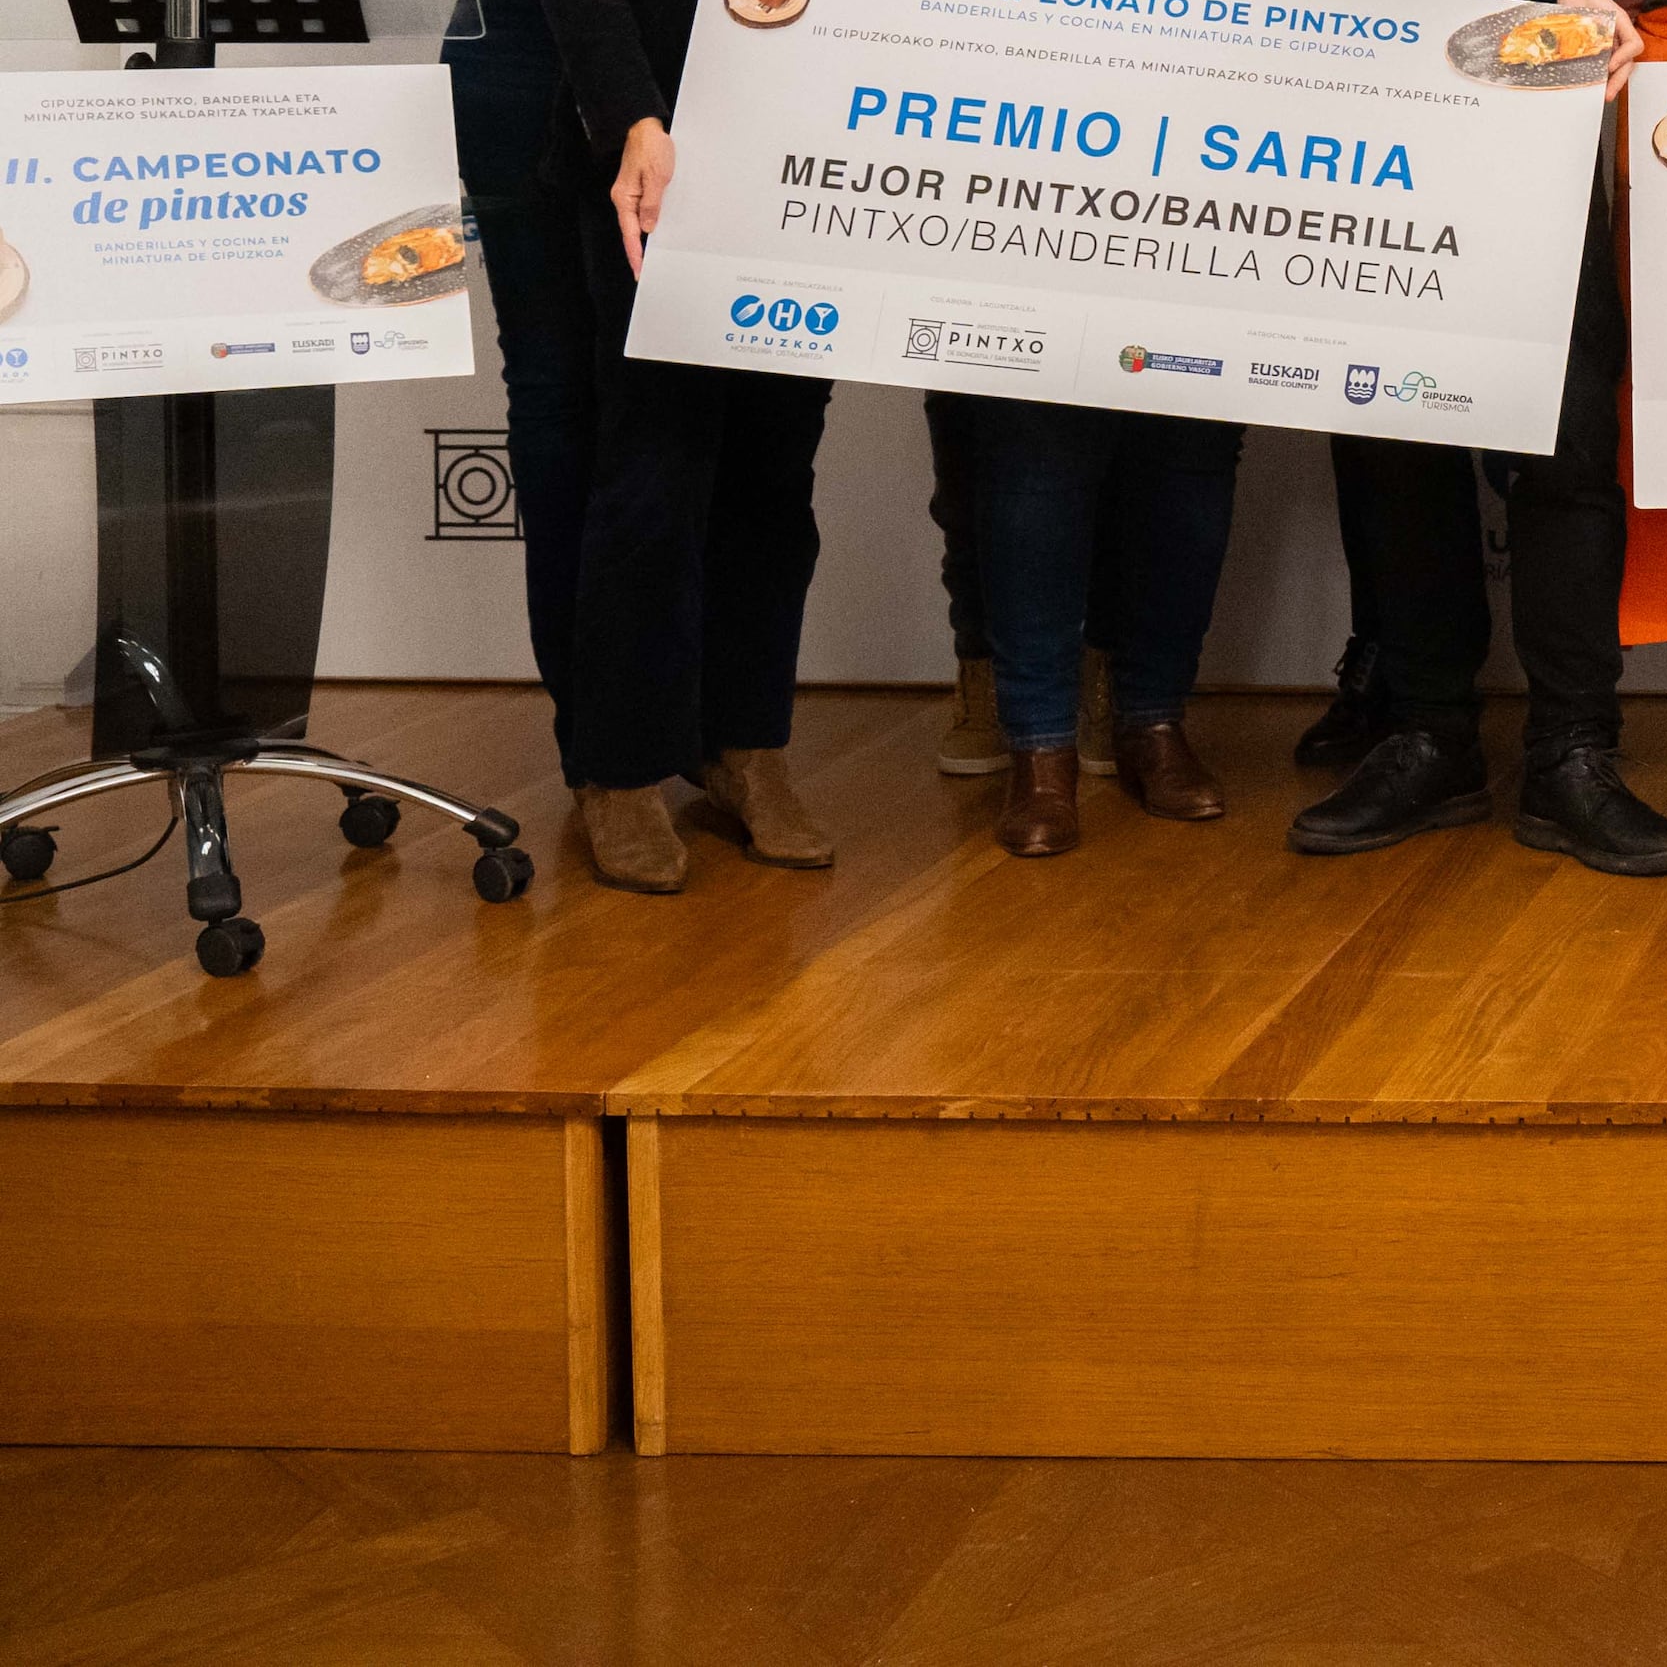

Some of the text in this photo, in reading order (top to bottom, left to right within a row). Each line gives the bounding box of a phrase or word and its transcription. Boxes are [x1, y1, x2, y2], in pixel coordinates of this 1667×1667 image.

[920, 0, 1375, 59] BANDERILLAS Y COCINA EN MINIATURA DE GIPUZKOA
[1203, 0, 1251, 25] DE
[1264, 6, 1419, 43] PINTXOS
[812, 25, 1480, 107] III GIPUZKOAKO PINTXO, BANDERILLA ETA MINIATURAZKO SUKALDARITZA TXAPELKETA
[40, 94, 320, 108] GIPUZKOAKO PINTXO, BANDERILLA ETA
[24, 106, 337, 121] MINIATURAZKO SUKALDARITZA TXAPELKETA
[847, 86, 1413, 190] PREMIO SARIA
[6, 148, 381, 184] II. CAMPEONATO
[73, 188, 308, 230] de pintxos
[781, 154, 1459, 256] MEJOR PINTXO/BANDERILLA
[94, 236, 289, 252] BANDERILLAS Y COCINA EN
[781, 200, 1443, 300] PINTXO/BANDERILLA ONENA
[102, 249, 283, 265] MINIATURA DE GIPUZKOA
[725, 333, 832, 352] GIPUZKOA
[949, 331, 1043, 354] PINTXO
[101, 348, 164, 361] PINTXO
[1251, 362, 1319, 381] EUSKADI
[1248, 377, 1318, 390] BASQUE COUNTRY
[1422, 391, 1473, 404] GIPUZKOA
